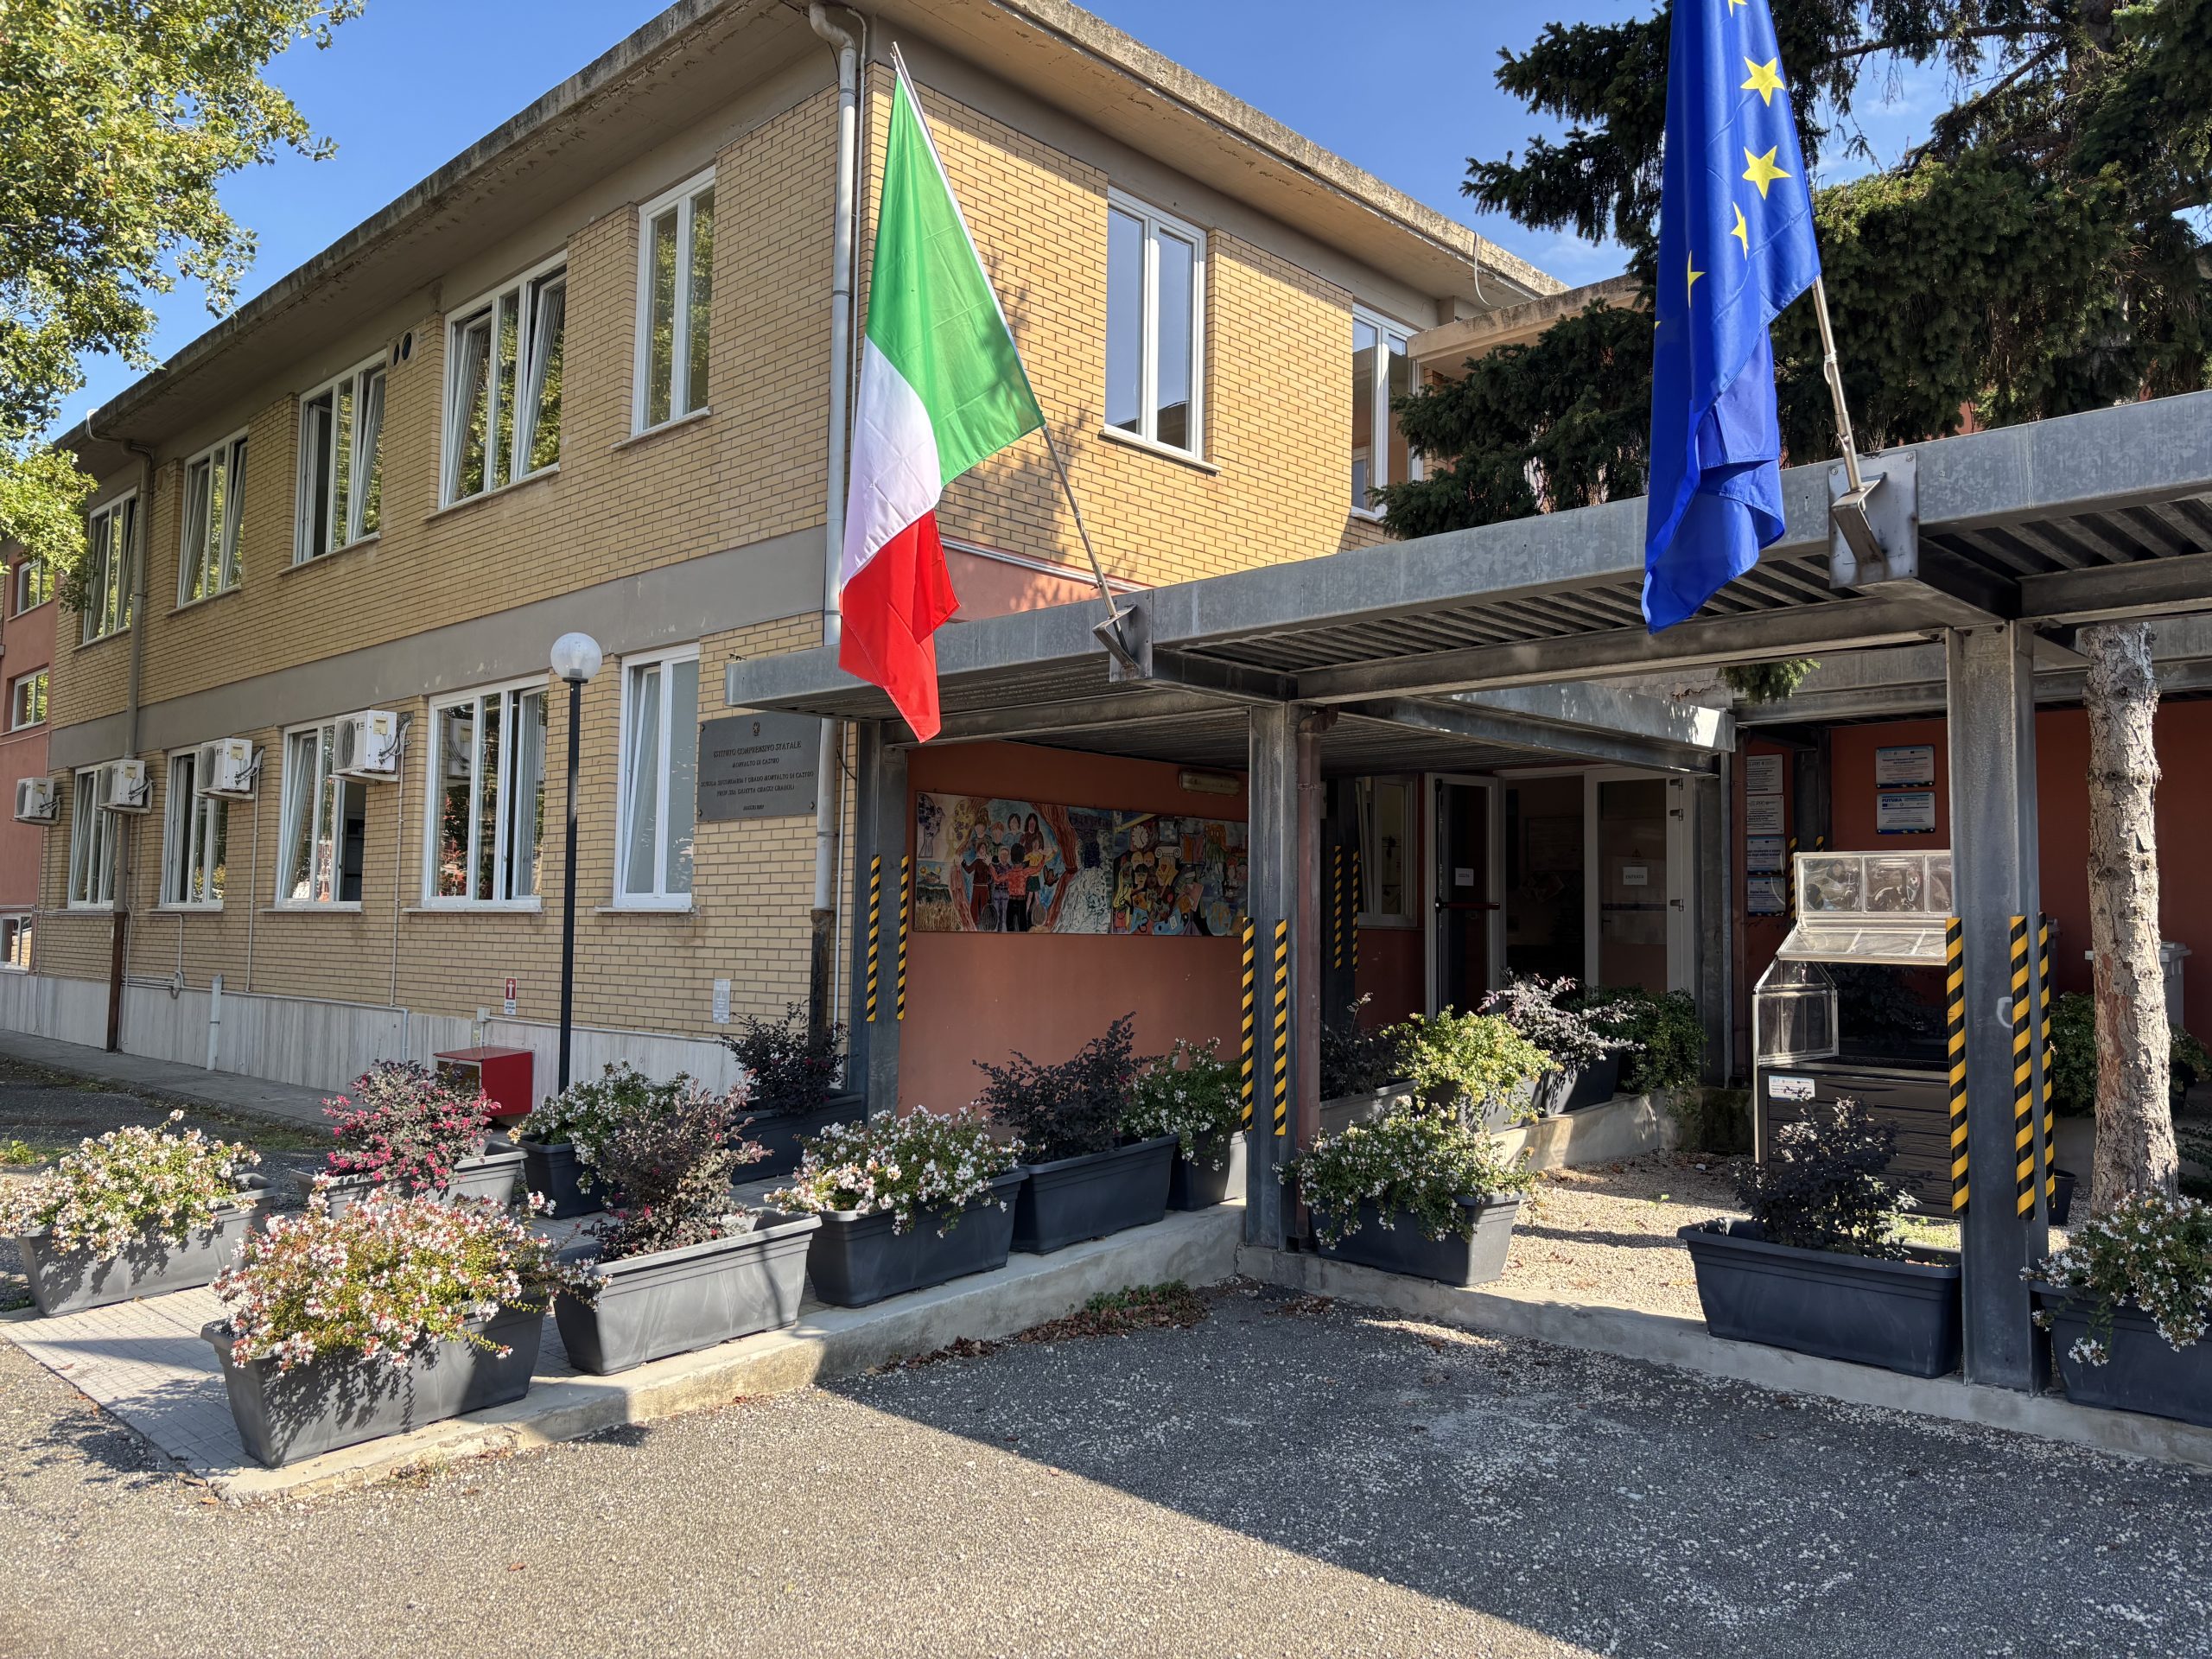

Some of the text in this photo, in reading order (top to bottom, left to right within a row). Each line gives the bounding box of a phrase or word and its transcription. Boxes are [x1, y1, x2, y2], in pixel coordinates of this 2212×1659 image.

[713, 741, 802, 759] ISTITUTO COMPRENSIVO STATALE
[732, 759, 756, 768] MONTALTO
[762, 757, 779, 766] CASTRO
[764, 772, 788, 782] MONTALTO
[795, 770, 814, 779] CASTRO
